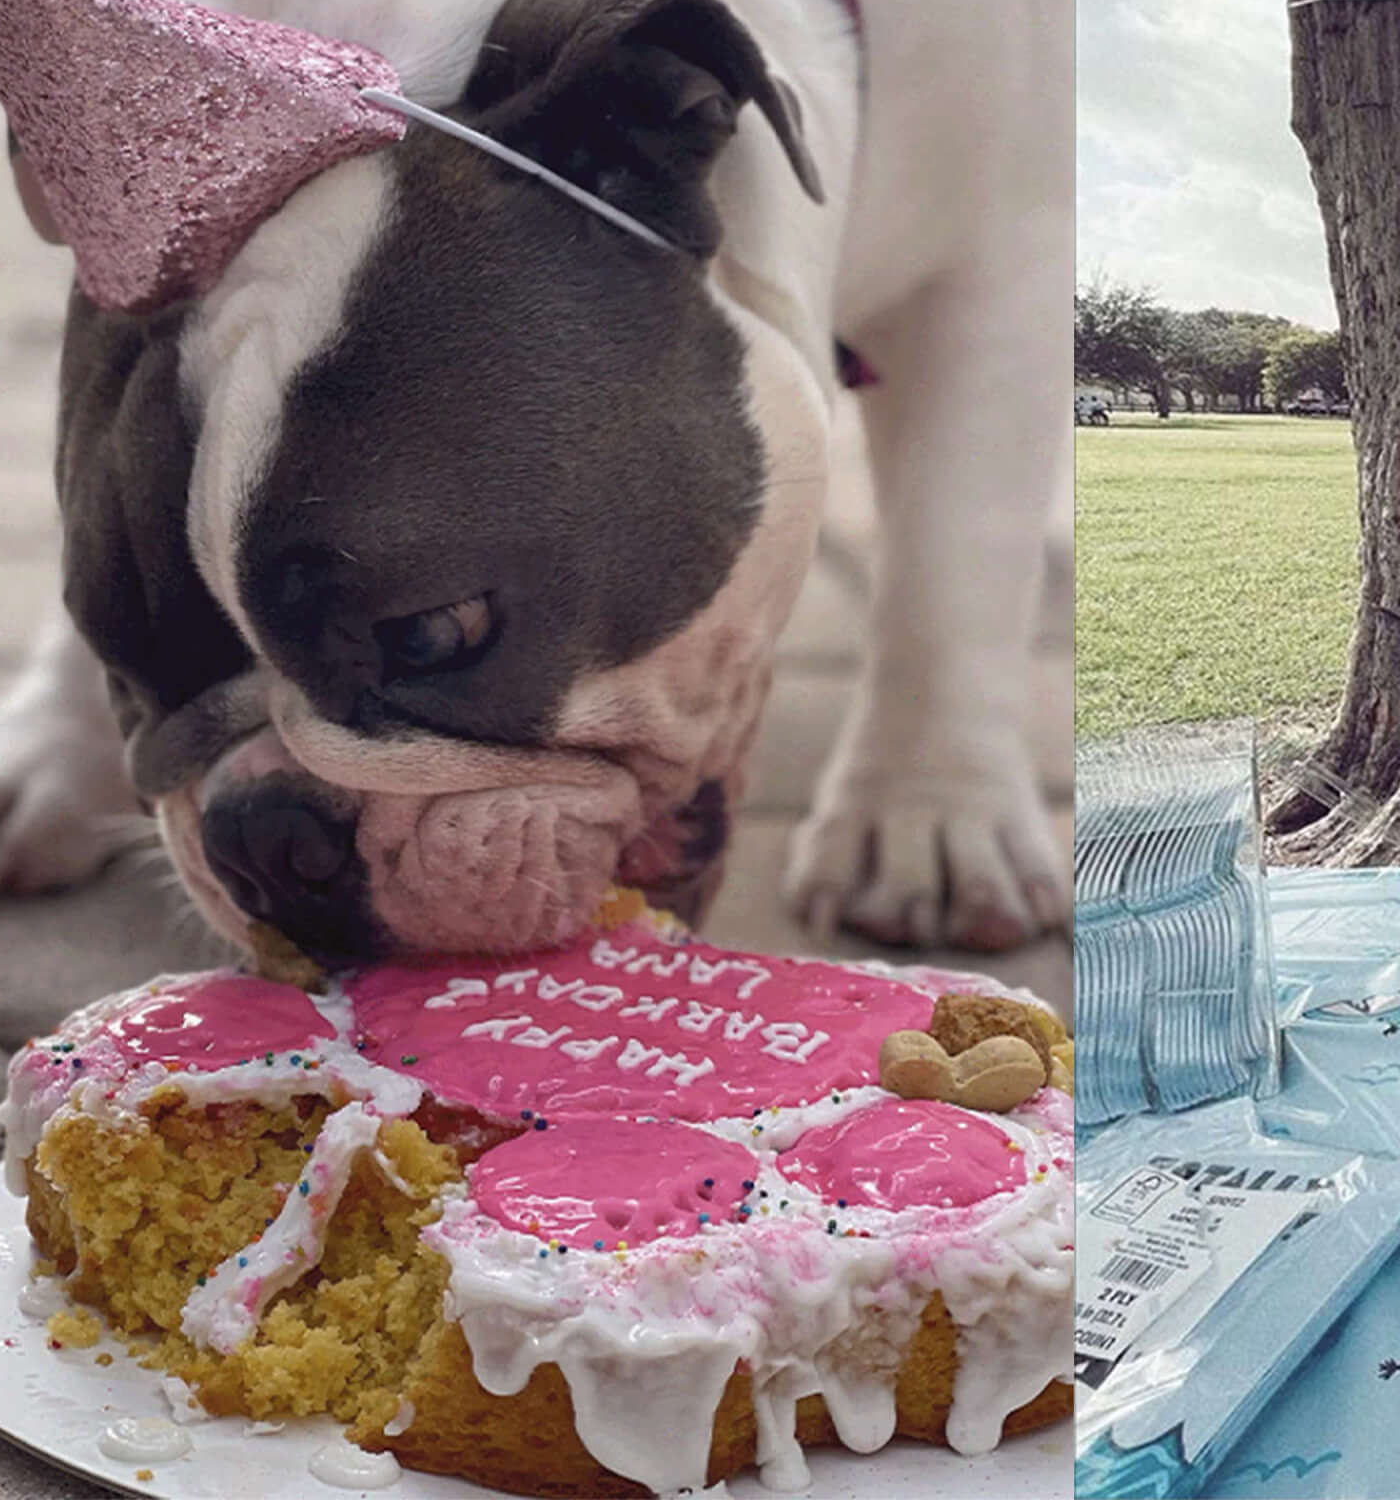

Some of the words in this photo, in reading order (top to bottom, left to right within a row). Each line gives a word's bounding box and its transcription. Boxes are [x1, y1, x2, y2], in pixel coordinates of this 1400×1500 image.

[590, 939, 772, 999] LANA
[461, 1015, 716, 1086] HAPPY
[494, 969, 831, 1064] BARKDAY
